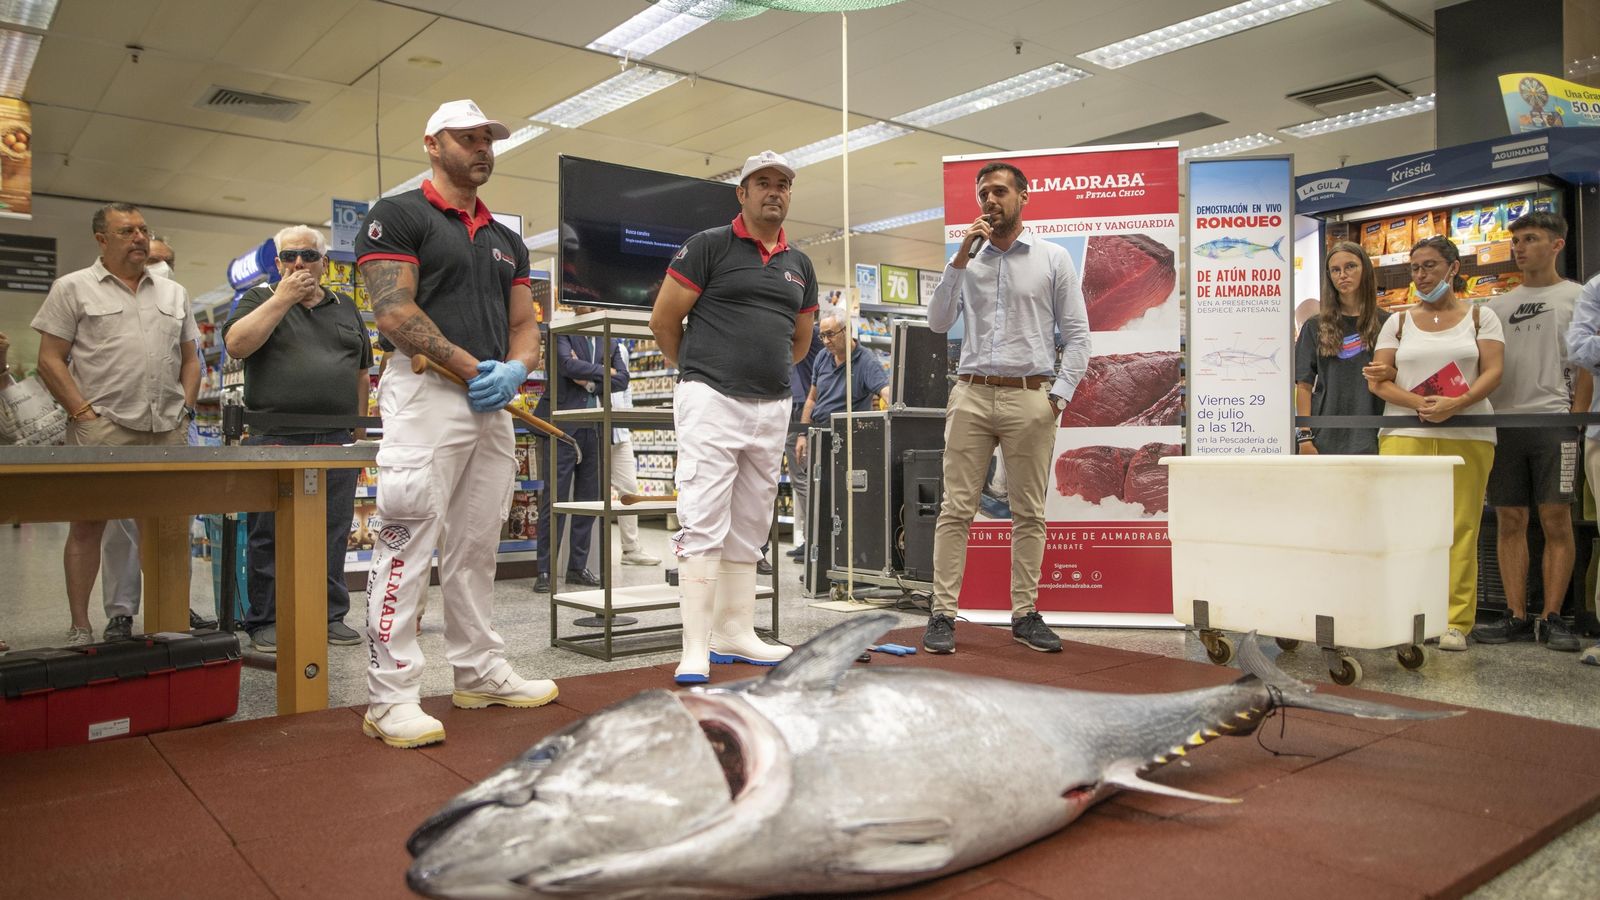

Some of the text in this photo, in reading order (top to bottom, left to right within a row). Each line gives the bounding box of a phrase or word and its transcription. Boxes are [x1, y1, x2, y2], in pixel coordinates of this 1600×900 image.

[1564, 89, 1582, 98] Una
[1391, 162, 1431, 183] Krissia
[1085, 191, 1117, 200] PETACA
[1119, 189, 1145, 198] CHICO
[1303, 181, 1340, 196] LA GULA
[1197, 203, 1282, 215] DEMOSTRACIÓN EN VIVO
[335, 207, 357, 226] 10
[1196, 215, 1282, 229] RONQUEO
[1036, 222, 1093, 234] TRADICIÓN
[1095, 222, 1102, 232] Y
[1104, 219, 1175, 231] VANGUARDIA
[1197, 266, 1281, 282] DE ATÚN ROJO
[1197, 284, 1281, 298] DE ALMADRABA
[1516, 302, 1546, 315] NIKE
[1514, 324, 1543, 332] AIR
[1197, 394, 1266, 406] Viernes 29
[1197, 408, 1244, 420] de julio
[1197, 421, 1255, 433] a las 12h.
[1220, 435, 1265, 444] Pescadería
[1197, 446, 1282, 455] Hipercor de Arabial
[998, 532, 1011, 540] RO
[1083, 532, 1096, 540] DE
[1101, 532, 1169, 540] ALMADRABA
